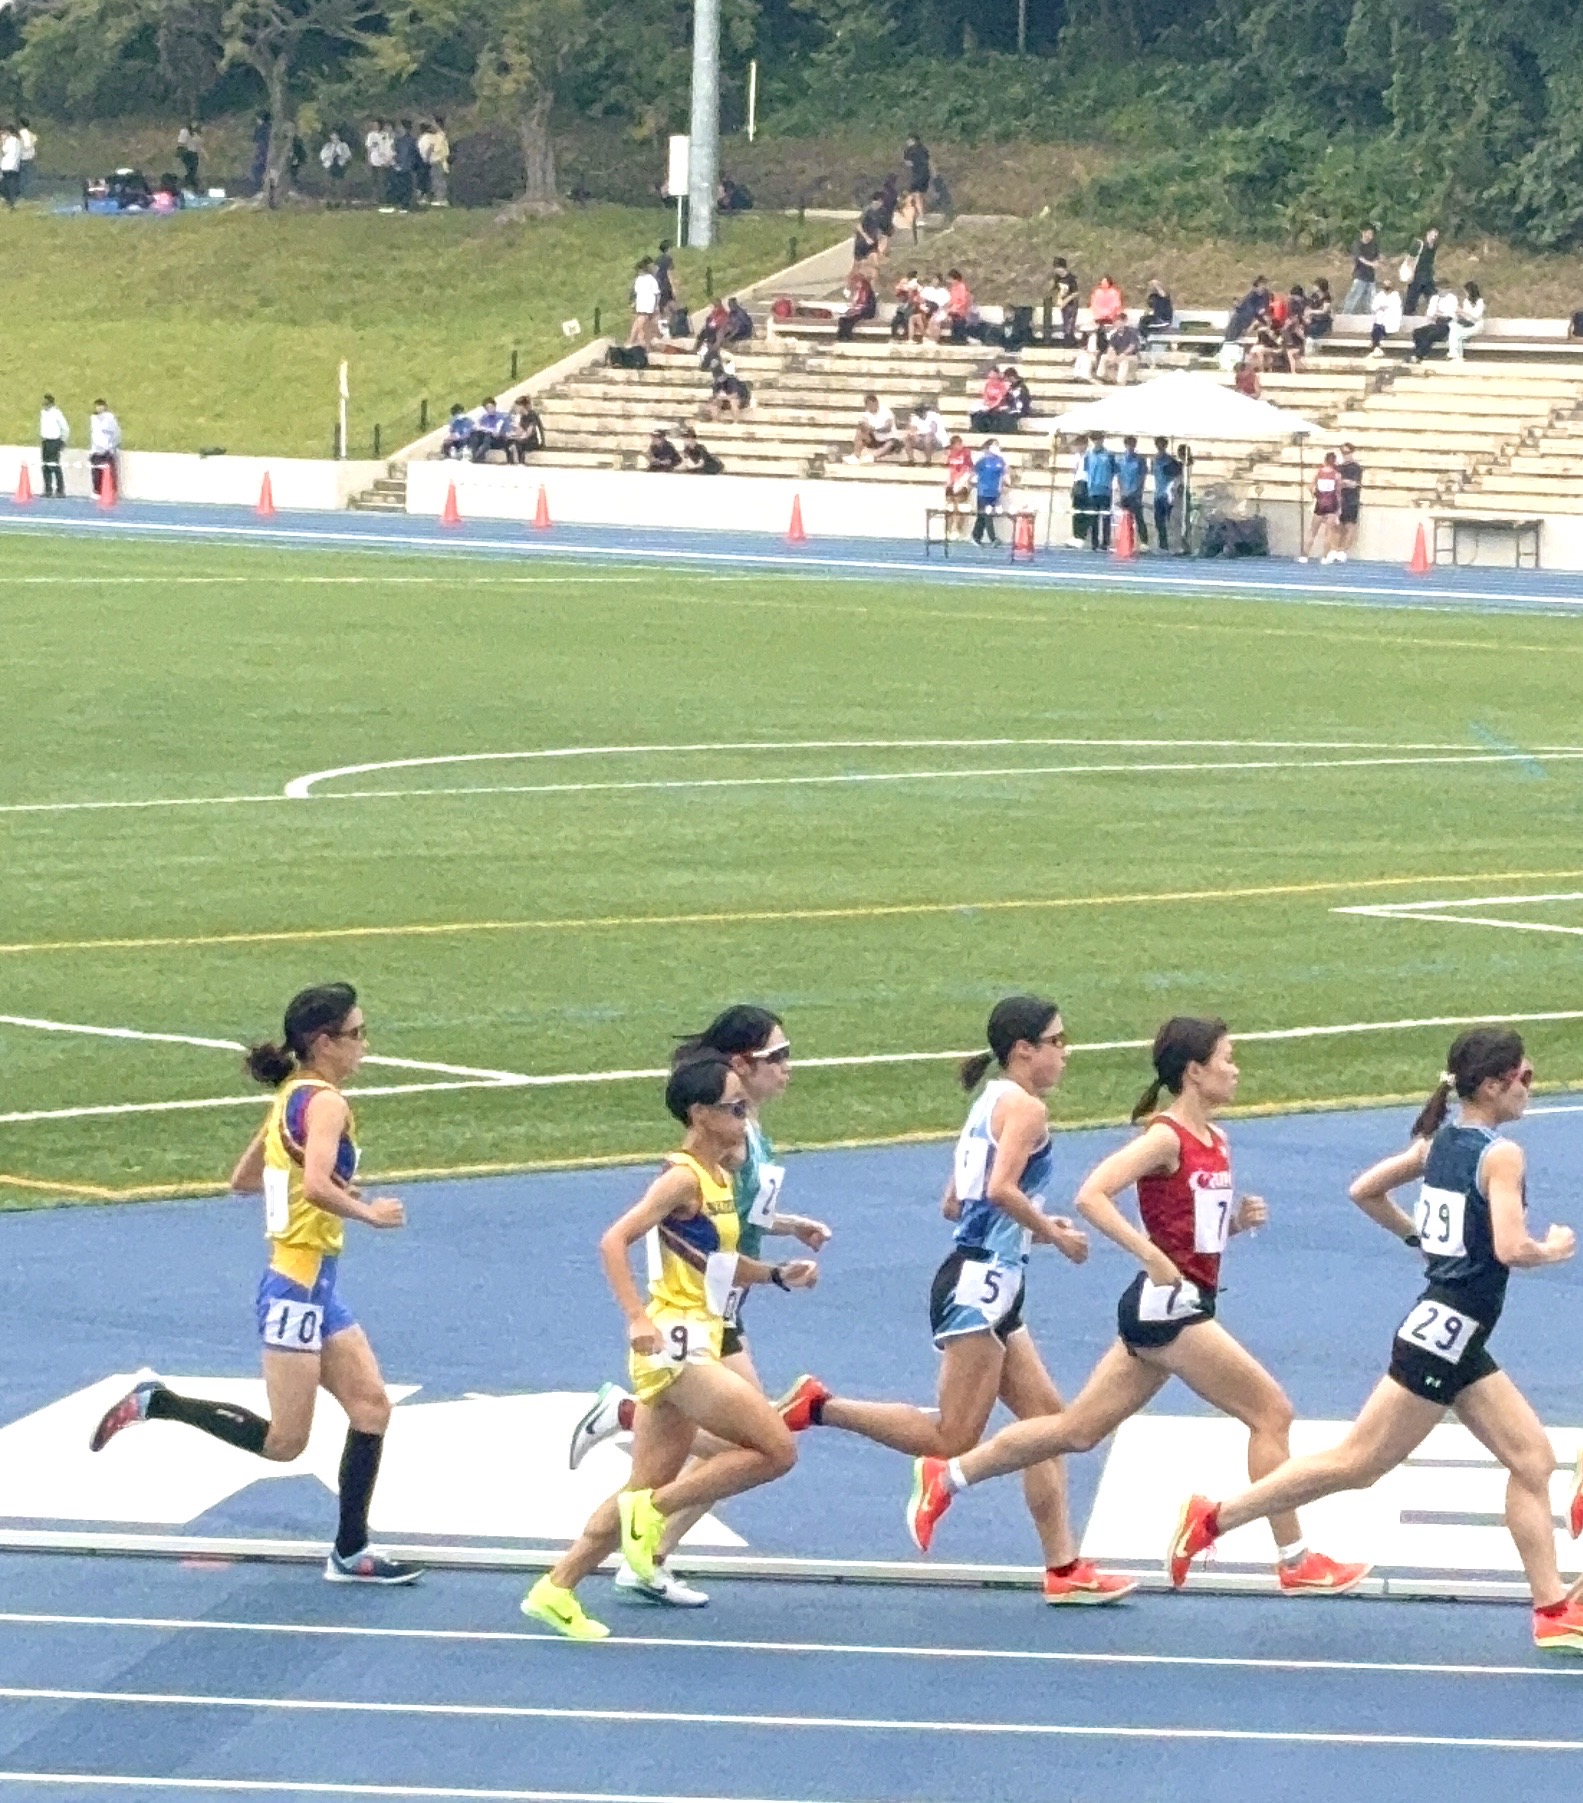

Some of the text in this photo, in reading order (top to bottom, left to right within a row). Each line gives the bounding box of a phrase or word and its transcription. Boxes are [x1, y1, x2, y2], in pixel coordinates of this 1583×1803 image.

[1422, 1200, 1450, 1243] 29
[981, 1269, 1004, 1304] 5
[277, 1305, 317, 1344] 10
[670, 1325, 689, 1361] 9
[1411, 1307, 1463, 1350] 29
